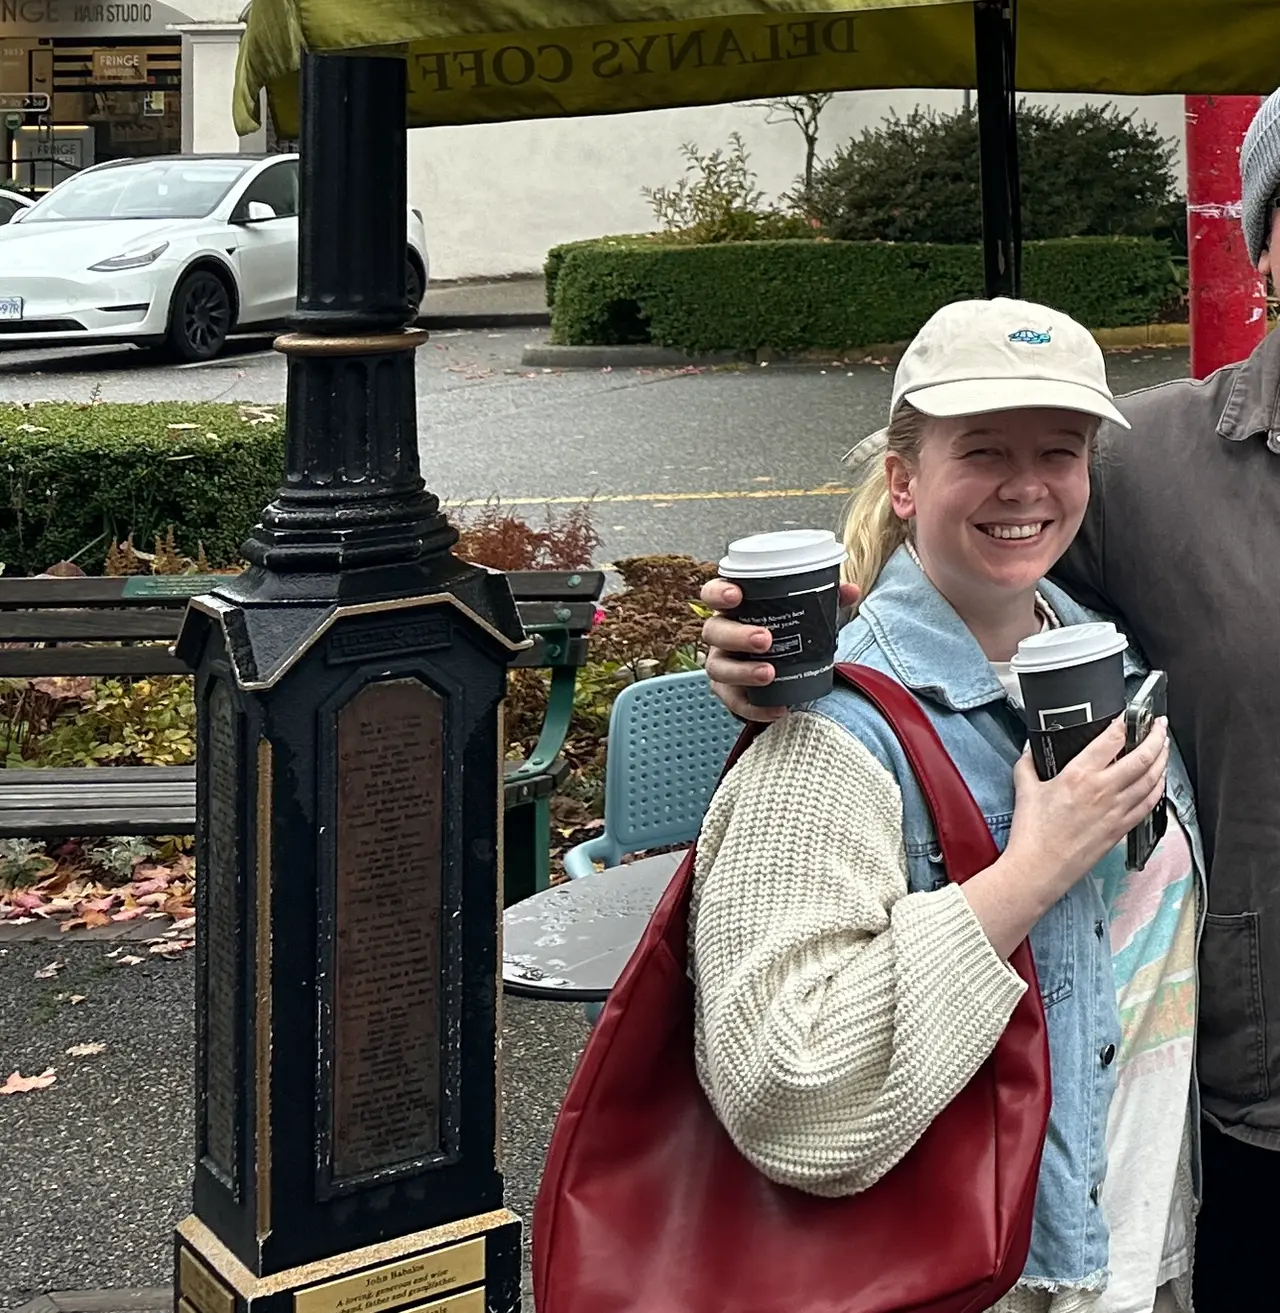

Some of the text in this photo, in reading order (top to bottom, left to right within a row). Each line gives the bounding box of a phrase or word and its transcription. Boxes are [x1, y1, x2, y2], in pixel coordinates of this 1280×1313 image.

[74, 4, 105, 22] HAIR
[106, 3, 152, 23] STUDIO
[100, 55, 140, 66] FRINGE
[37, 142, 76, 155] FRINGE
[365, 1274, 388, 1288] John
[412, 1273, 429, 1286] and
